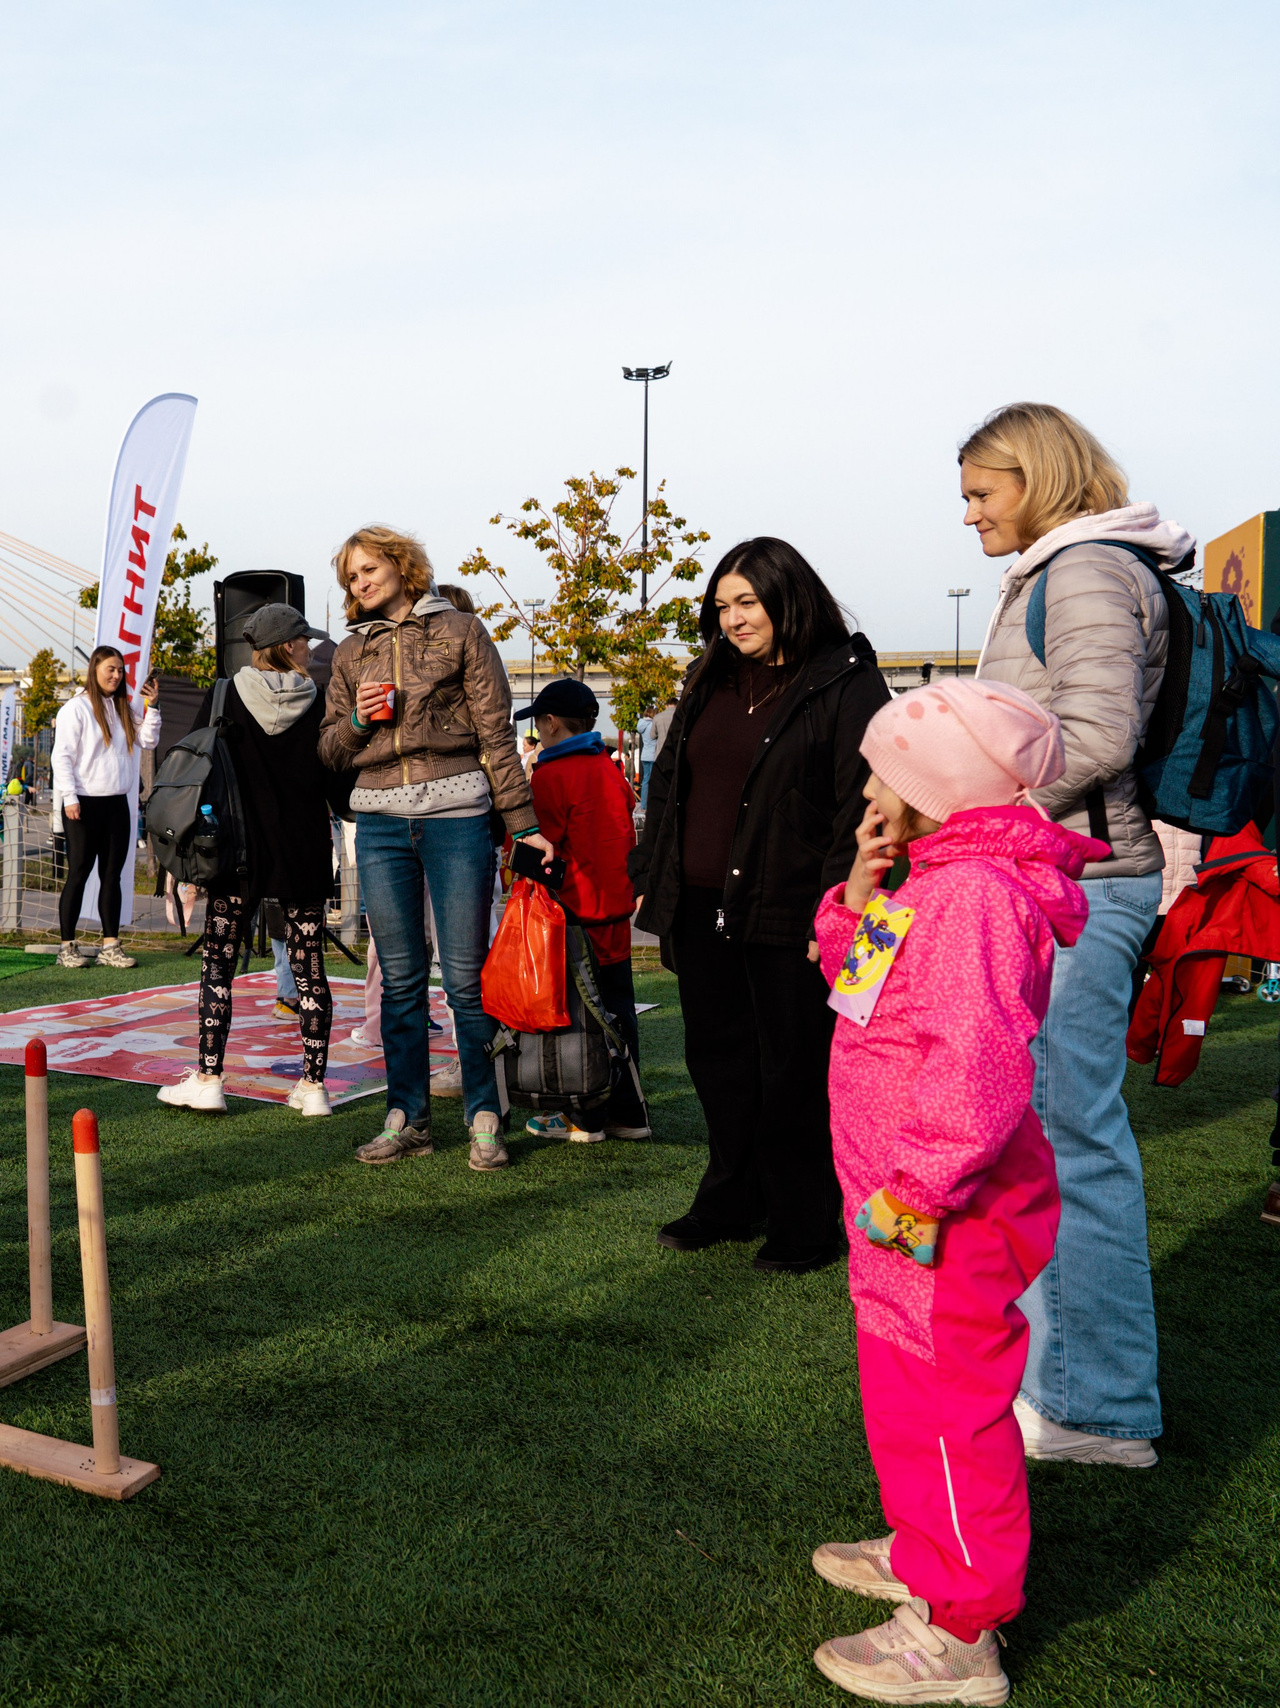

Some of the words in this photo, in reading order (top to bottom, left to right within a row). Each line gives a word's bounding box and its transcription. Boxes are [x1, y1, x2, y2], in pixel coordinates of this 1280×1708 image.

[119, 483, 157, 703] АГНИТ
[310, 952, 321, 980] Kappa
[302, 1036, 326, 1049] Kappa
